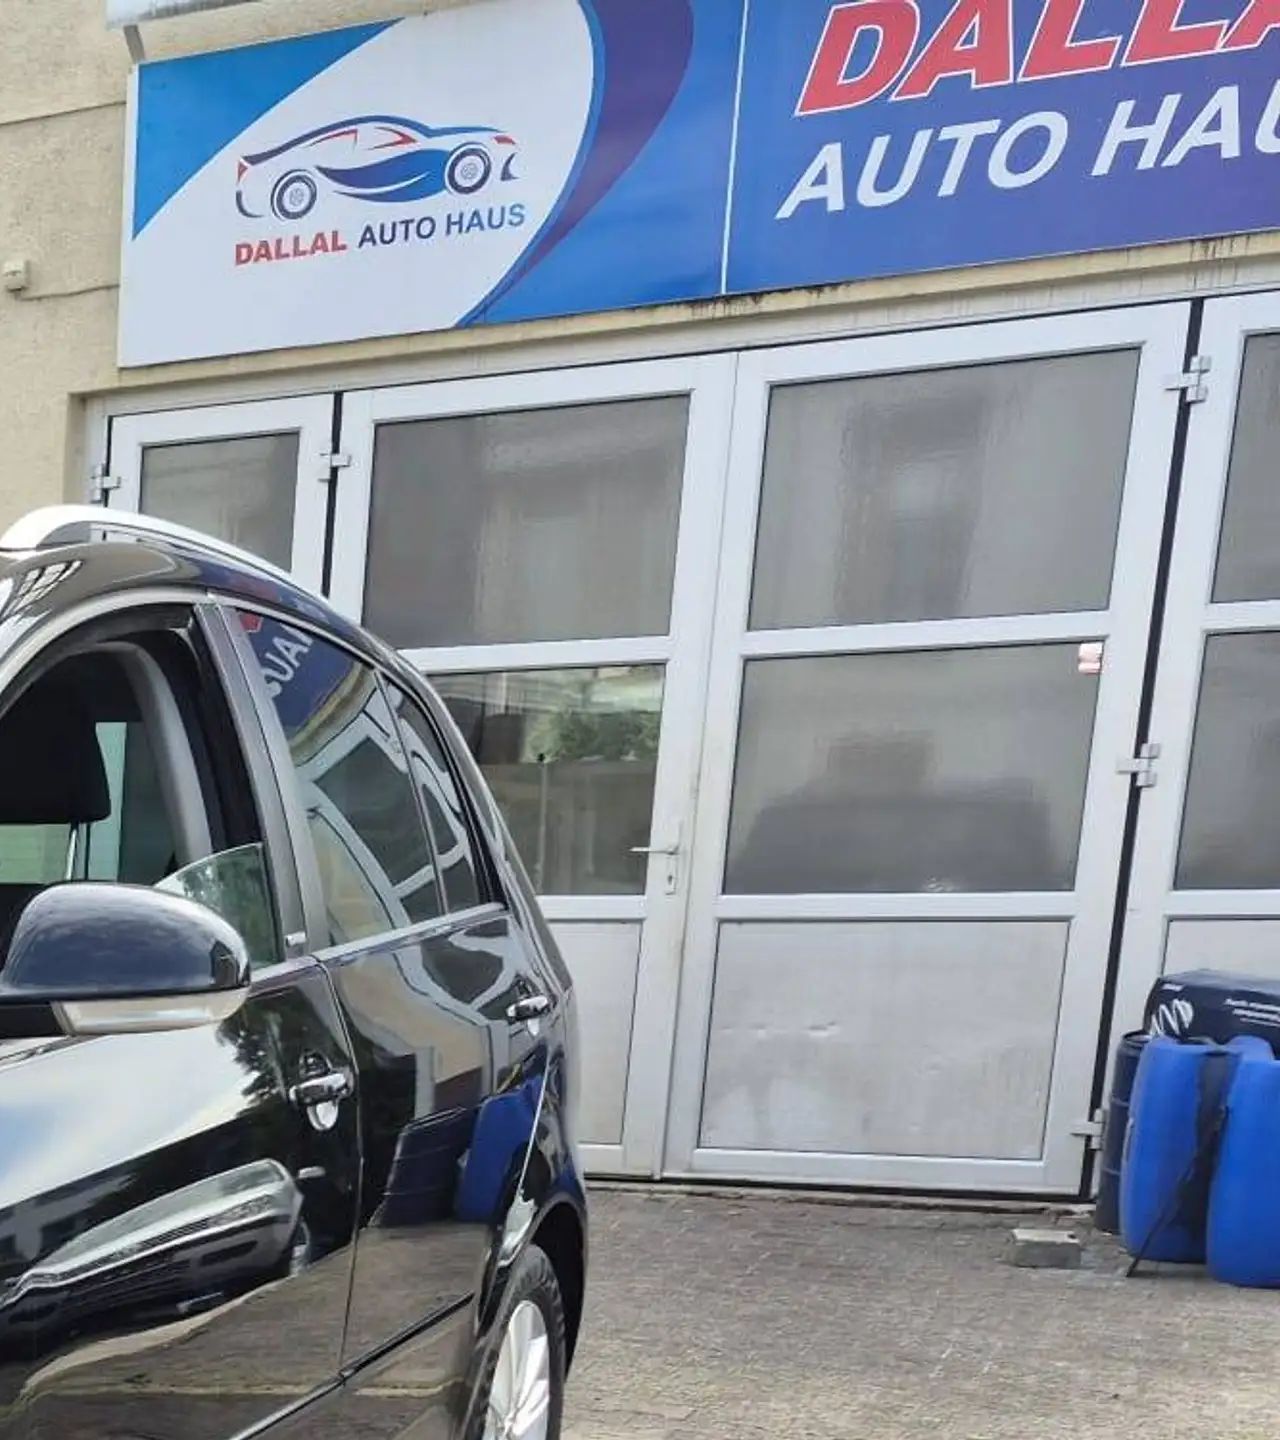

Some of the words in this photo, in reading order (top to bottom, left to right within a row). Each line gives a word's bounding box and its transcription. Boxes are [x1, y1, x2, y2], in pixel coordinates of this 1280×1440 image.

[774, 110, 1069, 220] AUTO
[235, 230, 348, 266] DALLAL
[358, 216, 437, 249] AUTO
[445, 203, 526, 236] HAUS
